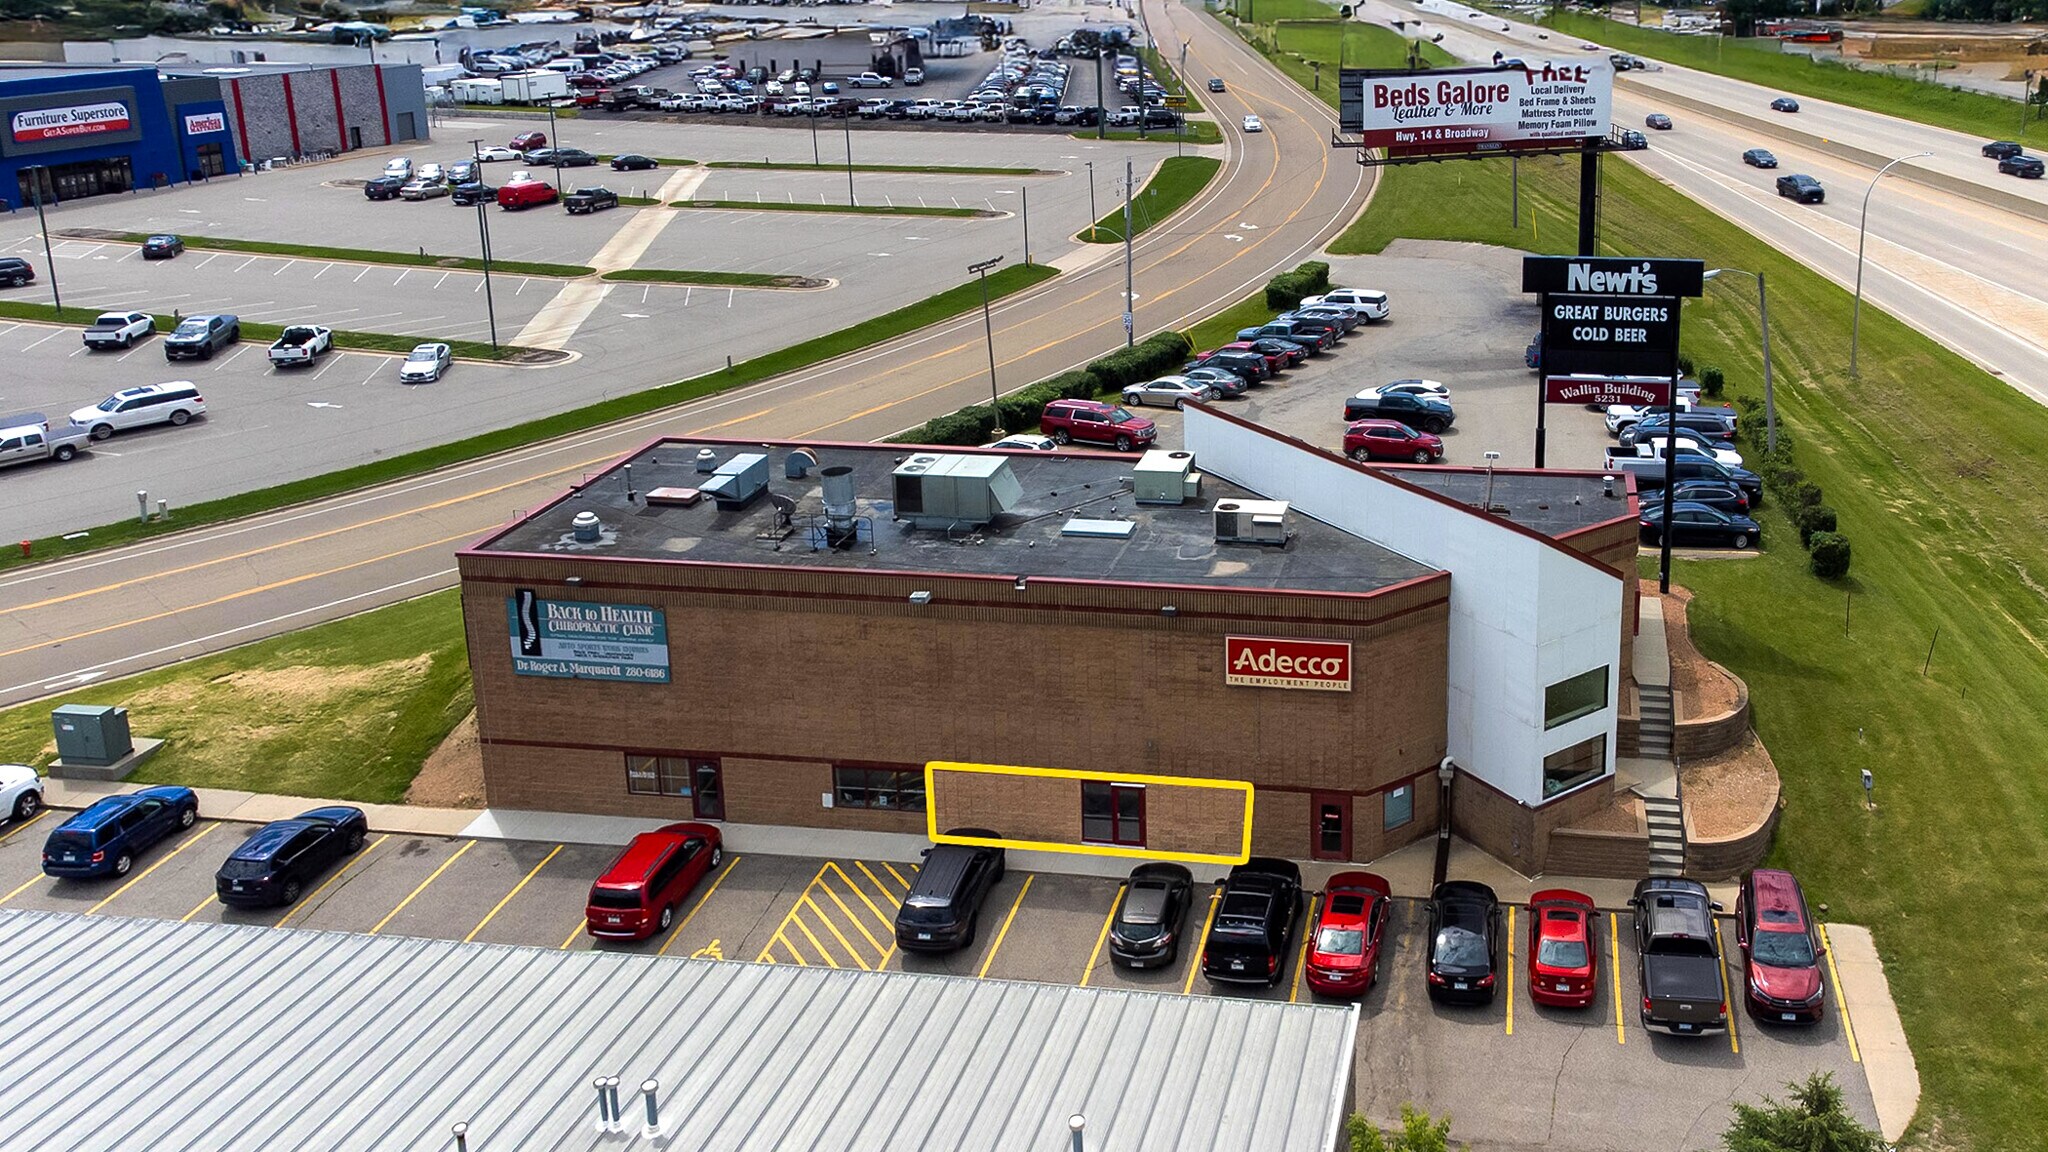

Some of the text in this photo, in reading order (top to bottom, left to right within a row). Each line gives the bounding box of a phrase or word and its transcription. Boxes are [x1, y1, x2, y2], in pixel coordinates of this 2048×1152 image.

[1374, 80, 1509, 108] Beds Galore
[1531, 85, 1585, 95] Local Delivery
[1519, 95, 1596, 107] Bed Frame & Sheets
[17, 107, 125, 127] Furniture Superstore
[1392, 102, 1492, 123] Leather & More
[1521, 108, 1593, 118] Mattress Protector
[1518, 119, 1597, 130] Memory Foam Pillow
[1395, 128, 1489, 142] Hwy. 14 & Broadway
[1567, 262, 1658, 295] Newt's
[1554, 305, 1668, 322] GREAT BURGERS
[1573, 327, 1647, 343] COLD BEER
[1560, 383, 1656, 403] Wallin Building
[1594, 395, 1622, 403] 5231
[547, 603, 653, 624] BACK to HEALTH
[548, 621, 654, 637] CHIROPRACTIC CLINIC
[530, 660, 558, 674] Roger
[569, 662, 621, 676] Marquardt
[625, 666, 665, 678] 280-6186
[1233, 647, 1343, 676] Adecco
[1229, 676, 1348, 689] THE EMPLOYMENT PEOPLE
